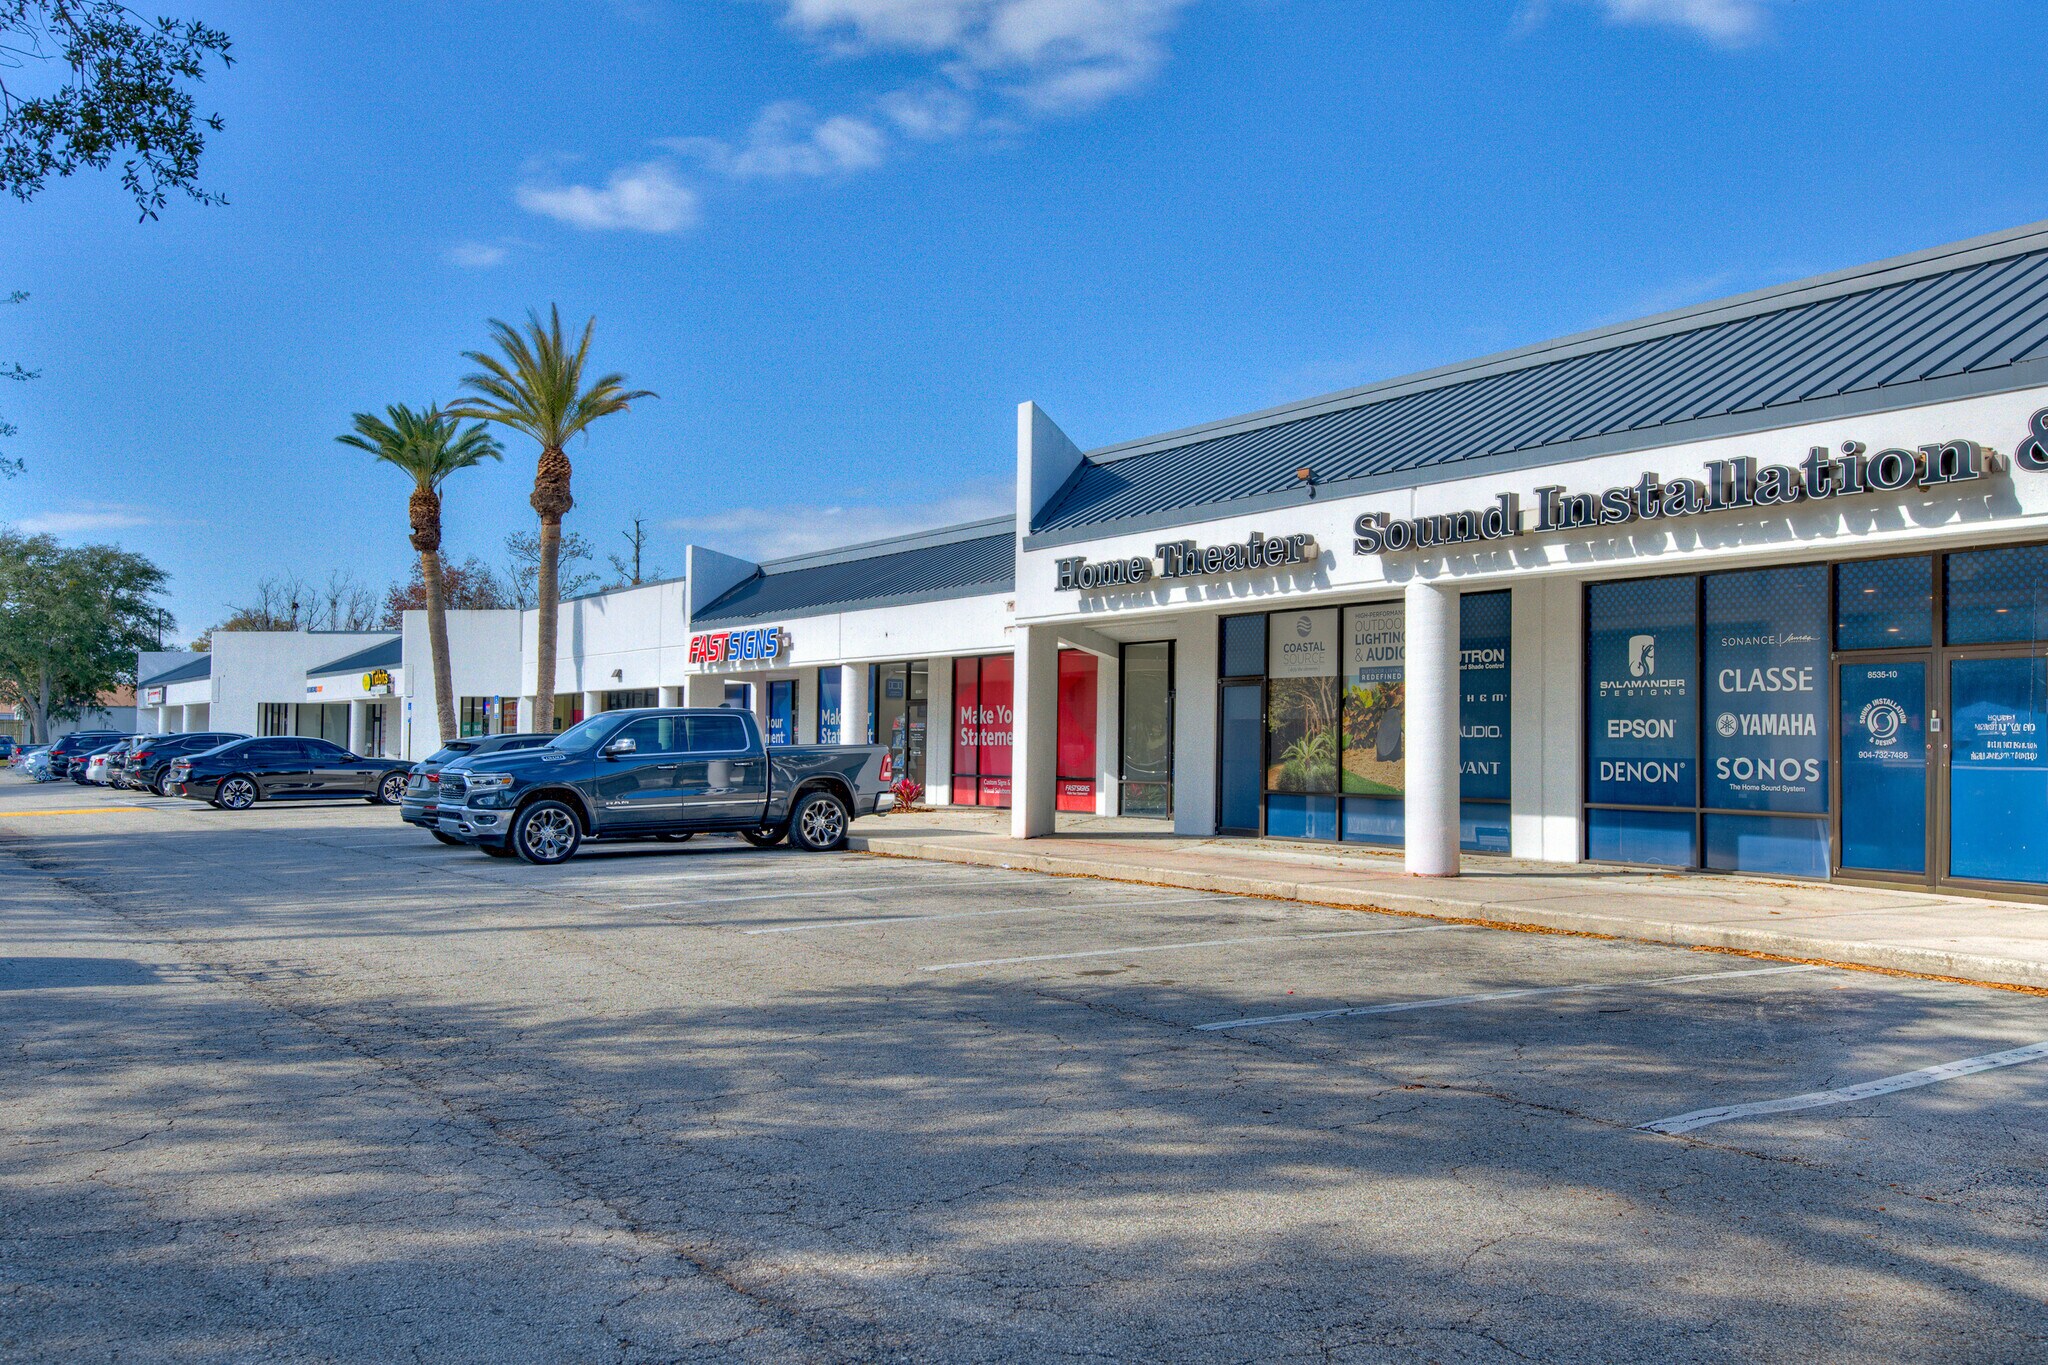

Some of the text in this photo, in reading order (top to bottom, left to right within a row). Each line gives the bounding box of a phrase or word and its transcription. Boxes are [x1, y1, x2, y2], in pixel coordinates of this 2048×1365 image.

[1054, 406, 2048, 592] Home Theater Sound Installation &
[1354, 610, 1405, 619] HIGH-PERFORMAN
[1354, 617, 1405, 632] OUTDOO
[1283, 641, 1326, 654] COASTAL
[1721, 635, 1776, 647] SONANCE
[1283, 652, 1325, 665] SOURCE
[1354, 647, 1363, 663] &
[1361, 673, 1402, 681] REDEFINED
[1867, 670, 1898, 679] 8535-10
[1600, 679, 1685, 689] SALAMANDER
[1600, 688, 1685, 697] DESIGNS
[961, 704, 994, 725] Make
[1860, 697, 1907, 725] SOUND INSTALLATION
[1607, 718, 1676, 738] EPSON
[1740, 713, 1817, 736] YAMAHA
[1875, 736, 1897, 746] DESIGN
[1716, 756, 1820, 782] SONOS
[1729, 783, 1741, 791] The
[1761, 784, 1781, 792] Sound
[1782, 784, 1806, 793] System
